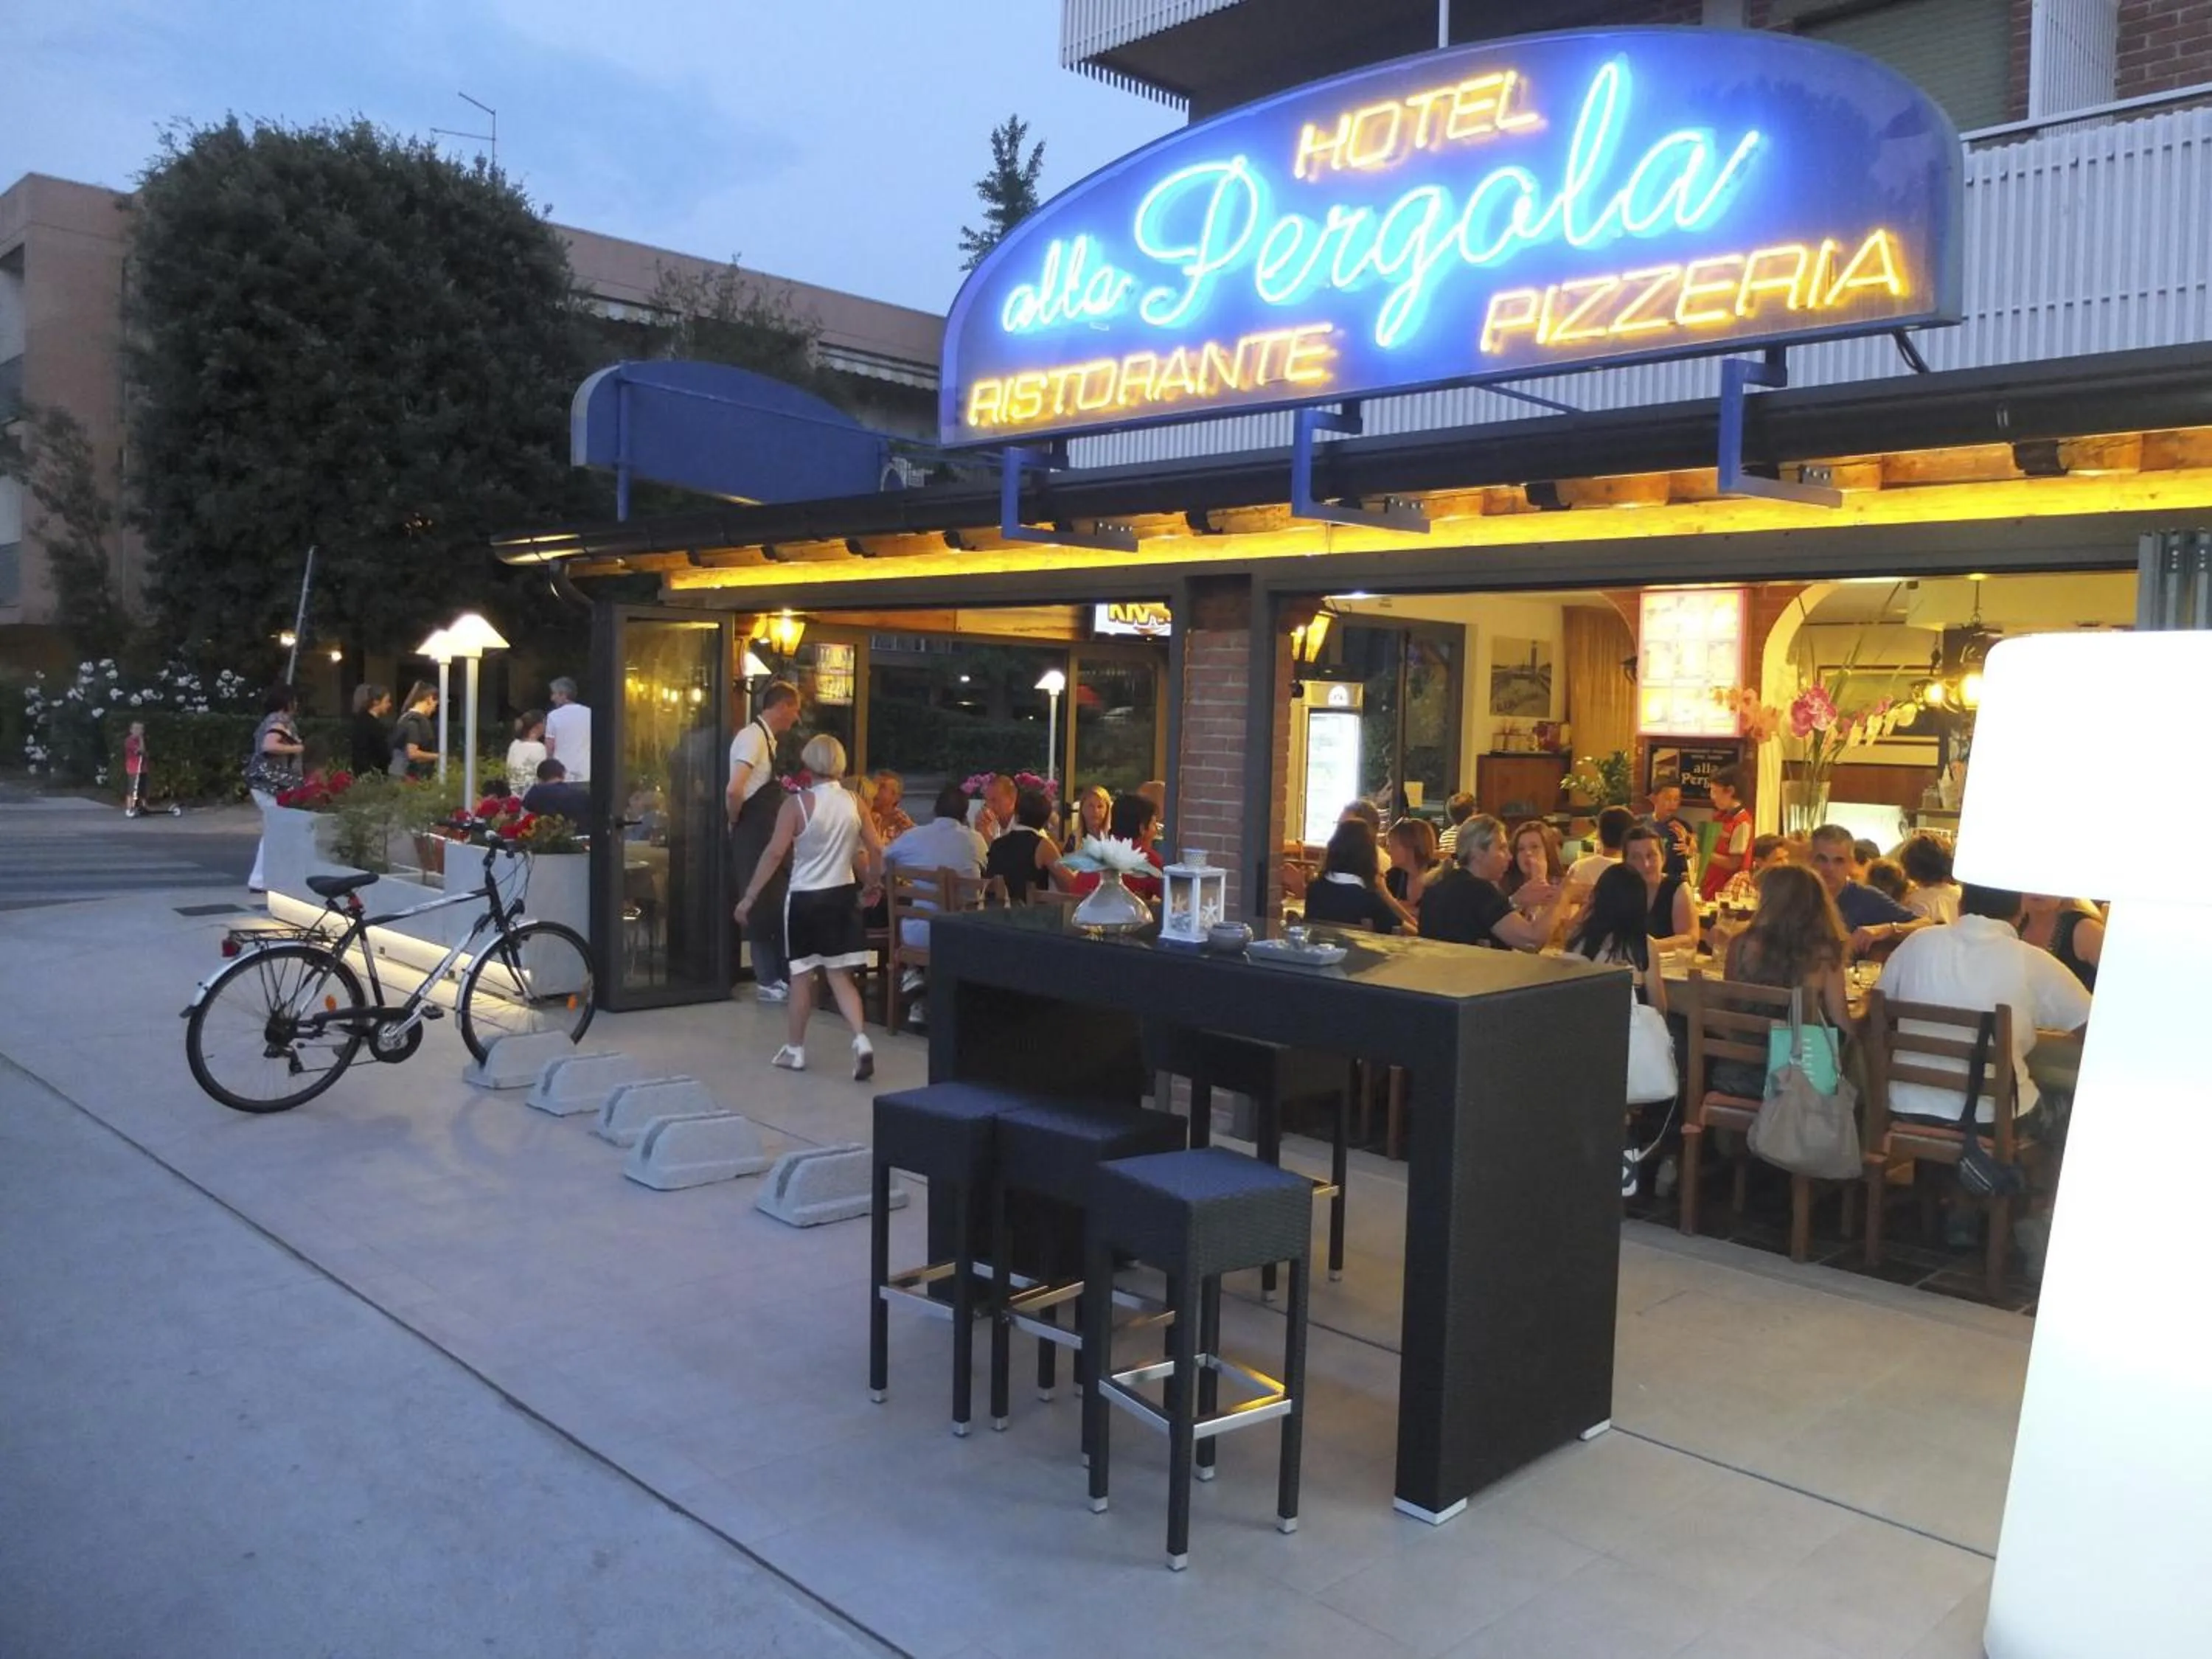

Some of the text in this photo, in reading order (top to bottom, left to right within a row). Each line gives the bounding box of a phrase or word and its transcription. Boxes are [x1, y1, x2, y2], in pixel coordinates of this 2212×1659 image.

[1293, 69, 1542, 181] HOTEL
[1001, 60, 1761, 347] alla Pergola
[1479, 229, 1904, 352] PIZZERIA
[967, 321, 1335, 426] RISTORANTE
